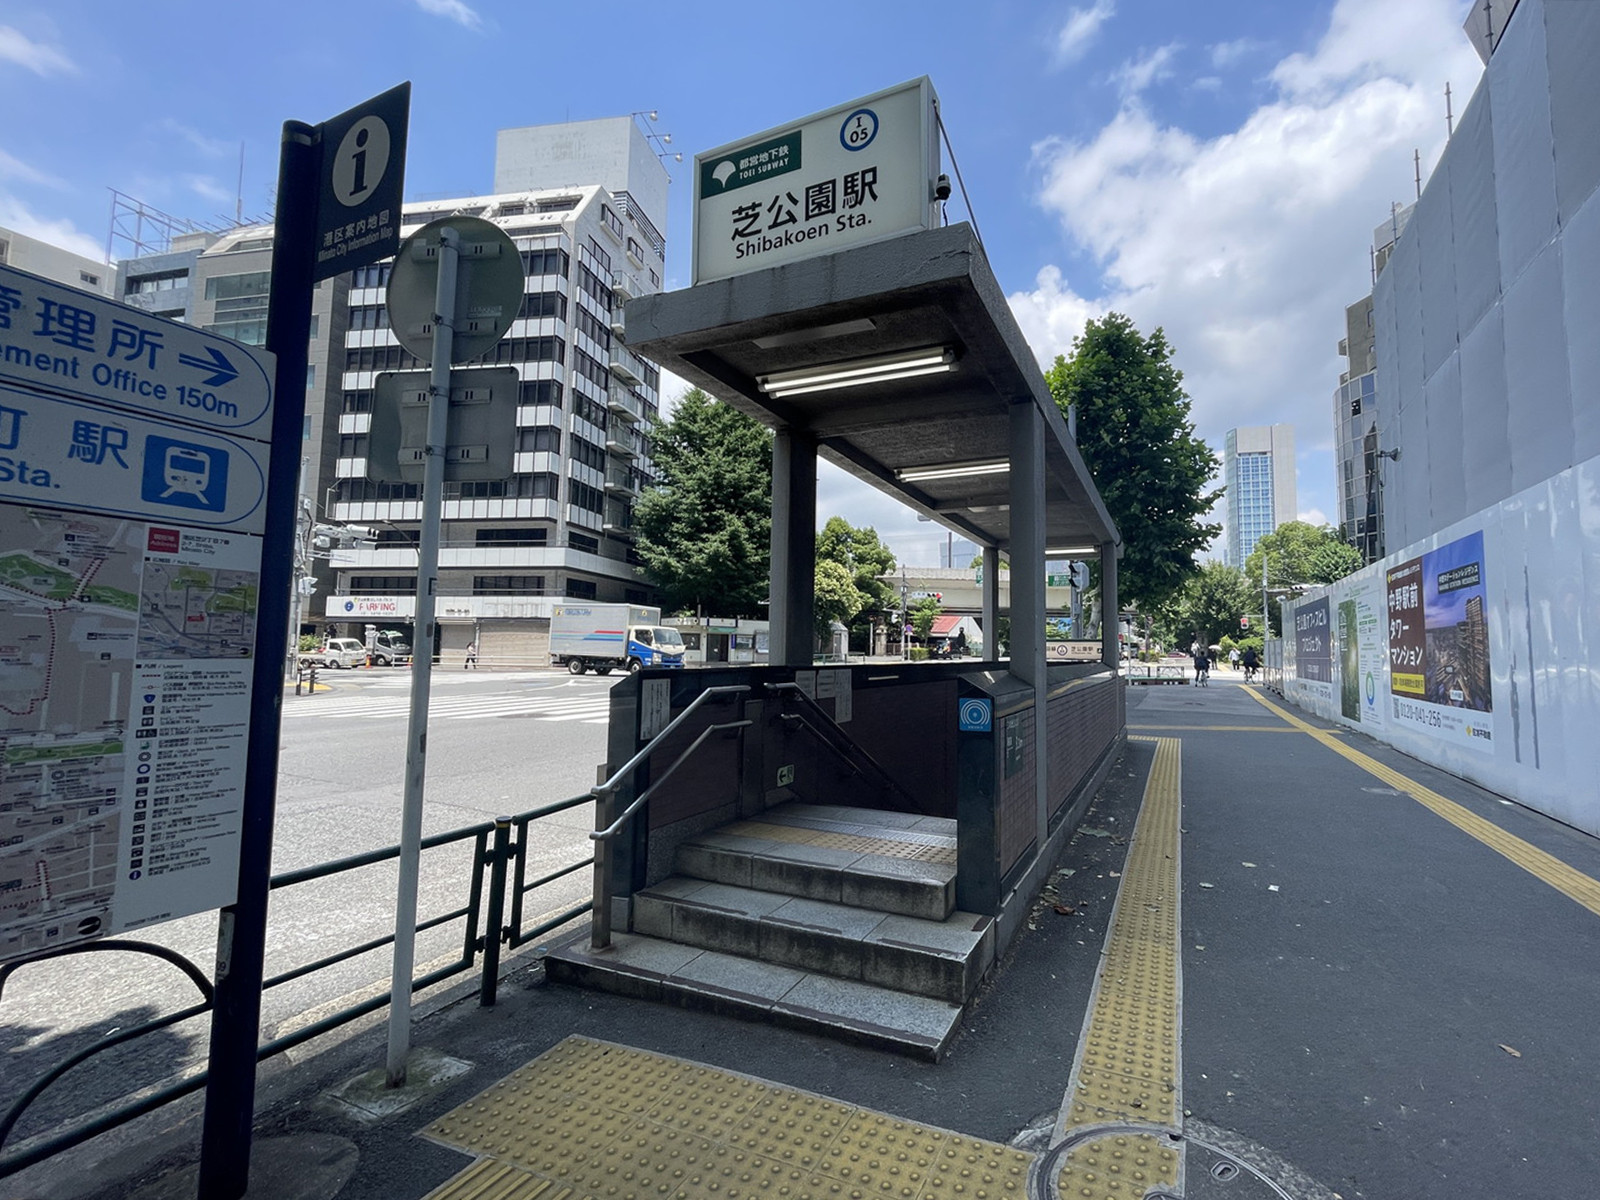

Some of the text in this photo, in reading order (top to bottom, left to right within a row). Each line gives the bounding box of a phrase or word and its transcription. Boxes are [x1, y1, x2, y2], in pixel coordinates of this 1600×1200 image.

[849, 127, 869, 144] 05
[739, 144, 789, 170] 都営地下鉄
[740, 157, 789, 180] TOEI SUBWAY
[731, 166, 878, 241] 芝公園駅
[323, 209, 390, 248] 港区案内地図
[736, 212, 872, 259] Shibakoen Sta.
[0, 345, 238, 418] ment Office 150m
[0, 456, 61, 490] Sta.
[1388, 583, 1418, 613] 中野駅前
[1390, 618, 1410, 640] タワー
[1391, 645, 1423, 667] マンション
